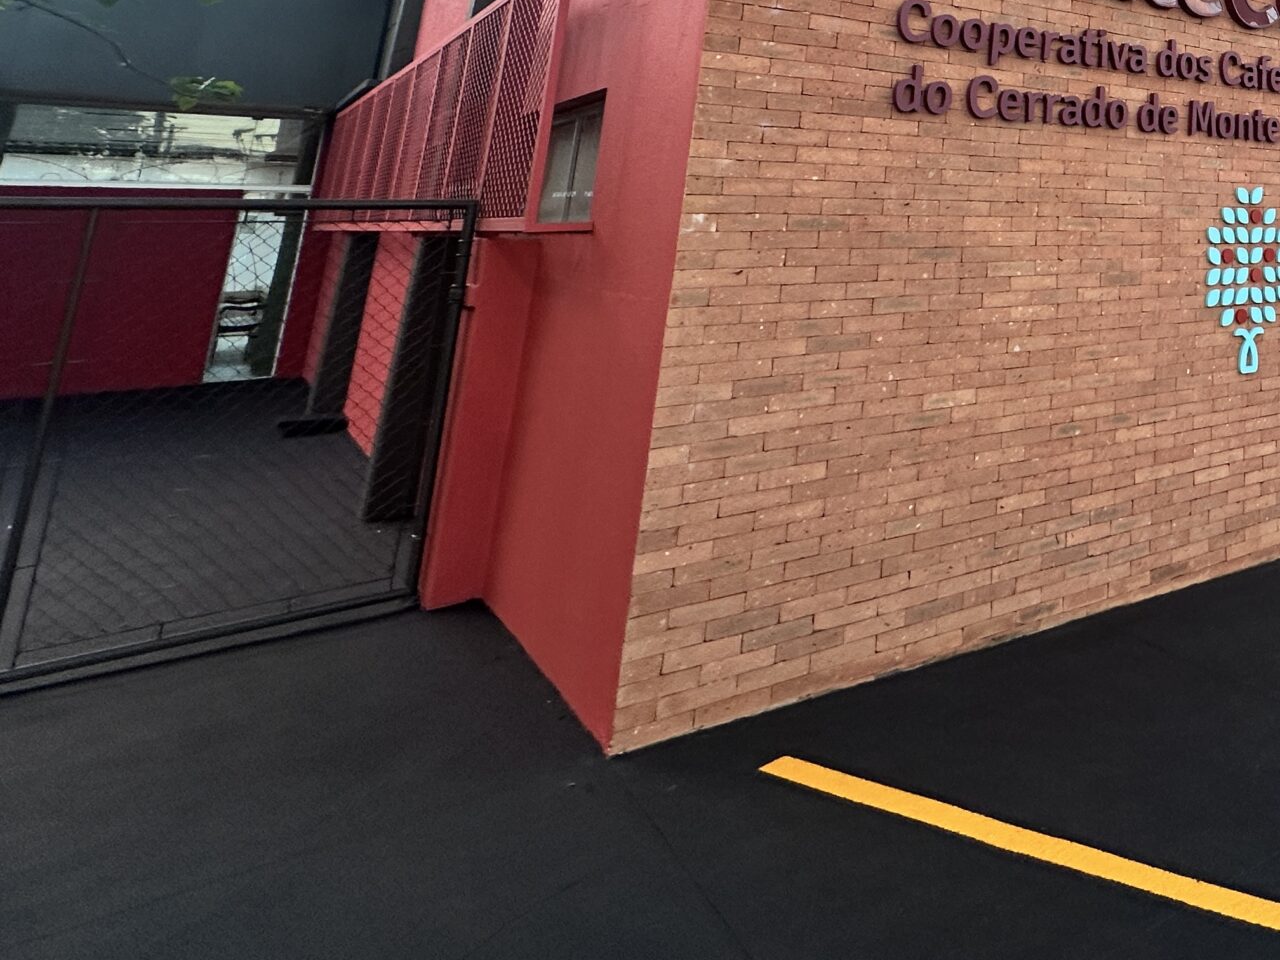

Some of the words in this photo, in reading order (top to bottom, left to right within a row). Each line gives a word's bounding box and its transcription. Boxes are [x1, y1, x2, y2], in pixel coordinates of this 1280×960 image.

[1156, 39, 1213, 83] dos
[893, 64, 953, 115] do
[966, 75, 1128, 130] Cerrado
[1137, 92, 1179, 134] de
[1188, 100, 1280, 143] Monte
